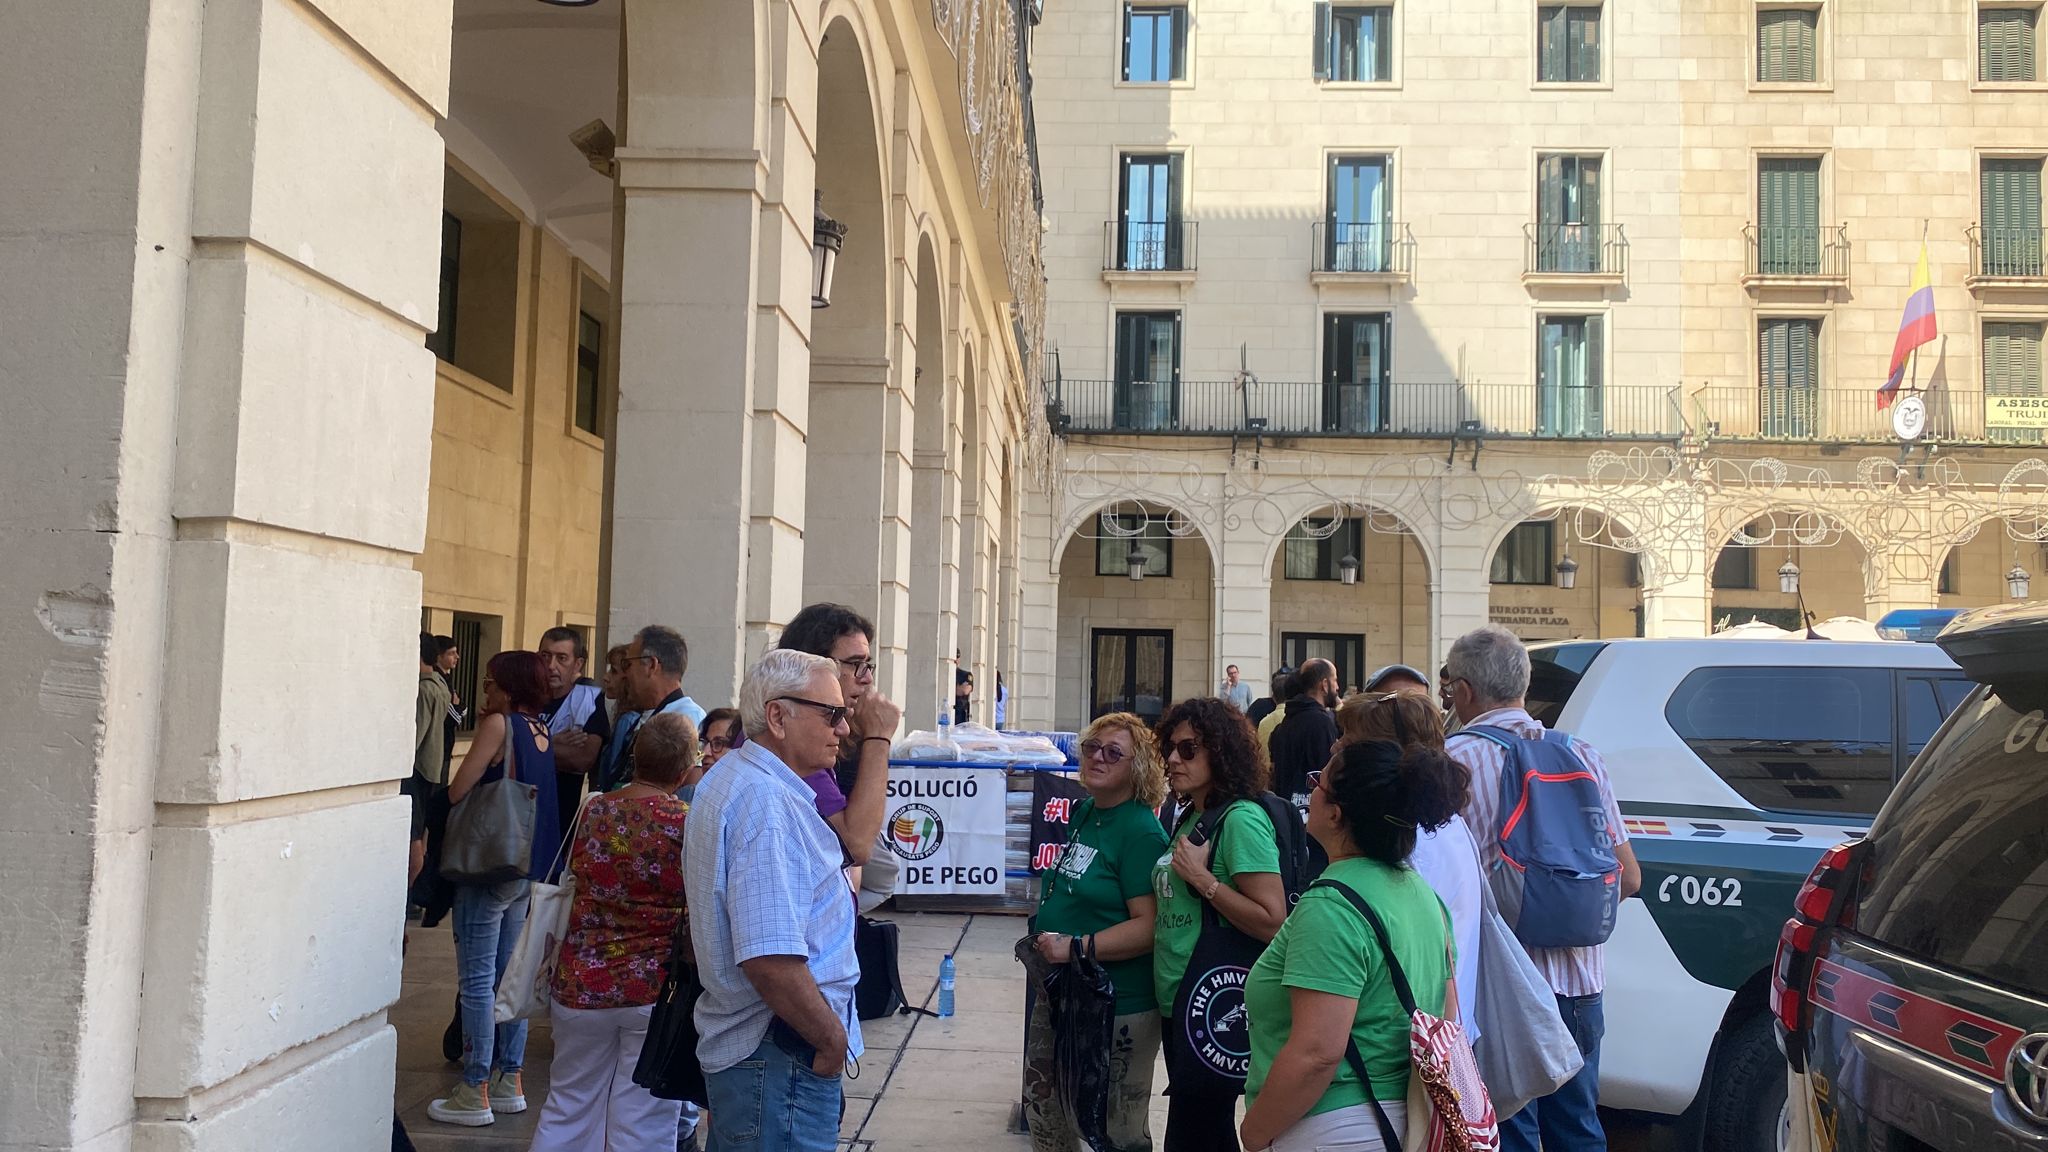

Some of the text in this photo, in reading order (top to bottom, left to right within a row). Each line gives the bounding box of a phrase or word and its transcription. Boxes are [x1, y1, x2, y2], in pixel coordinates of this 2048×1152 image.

[1540, 617, 1569, 625] PLAZA
[886, 775, 978, 798] SOLUCIÓ
[917, 804, 940, 822] SUPORT
[906, 867, 998, 885] DE PEGO
[1681, 875, 1742, 907] 062
[1192, 972, 1247, 1018] THE HMV
